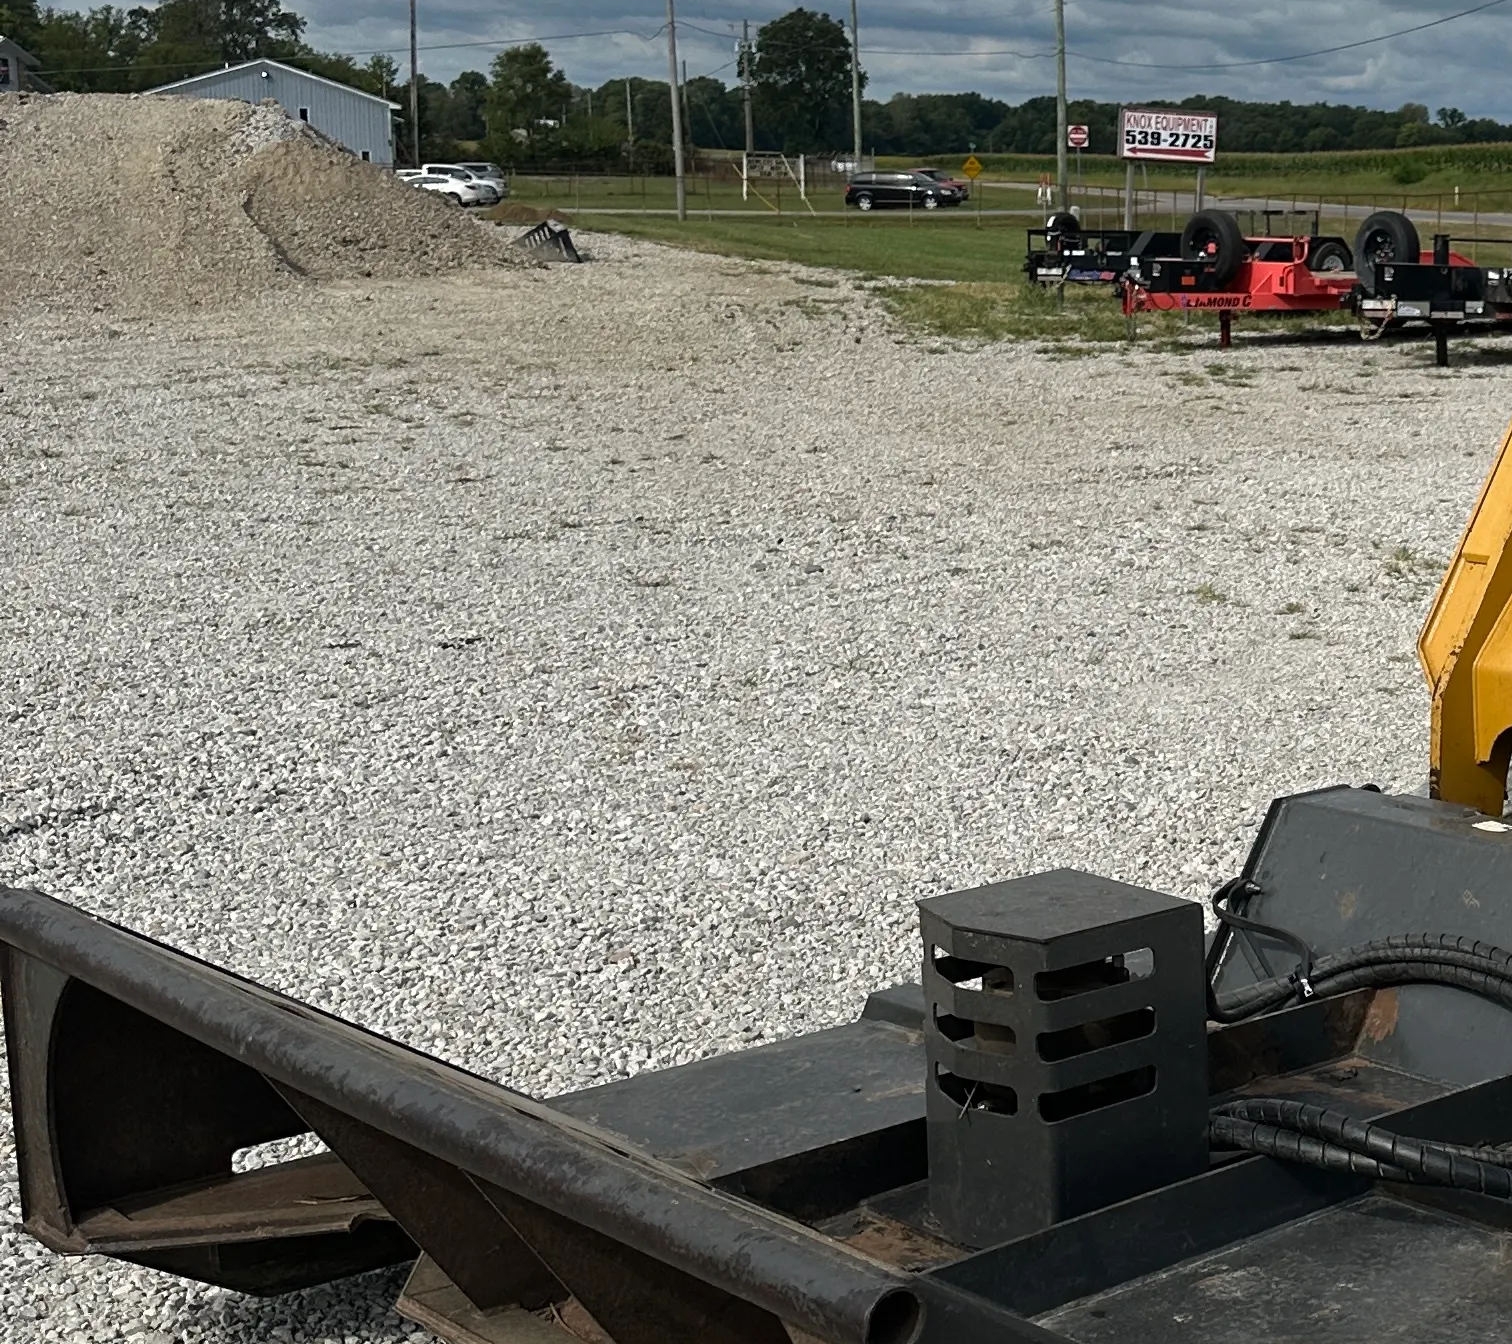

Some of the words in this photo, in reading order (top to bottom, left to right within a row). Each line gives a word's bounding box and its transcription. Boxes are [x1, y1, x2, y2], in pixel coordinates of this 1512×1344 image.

[1126, 114, 1153, 129] KNOX
[1155, 116, 1209, 132] EQUIPMENT
[1125, 130, 1214, 149] 539-2725
